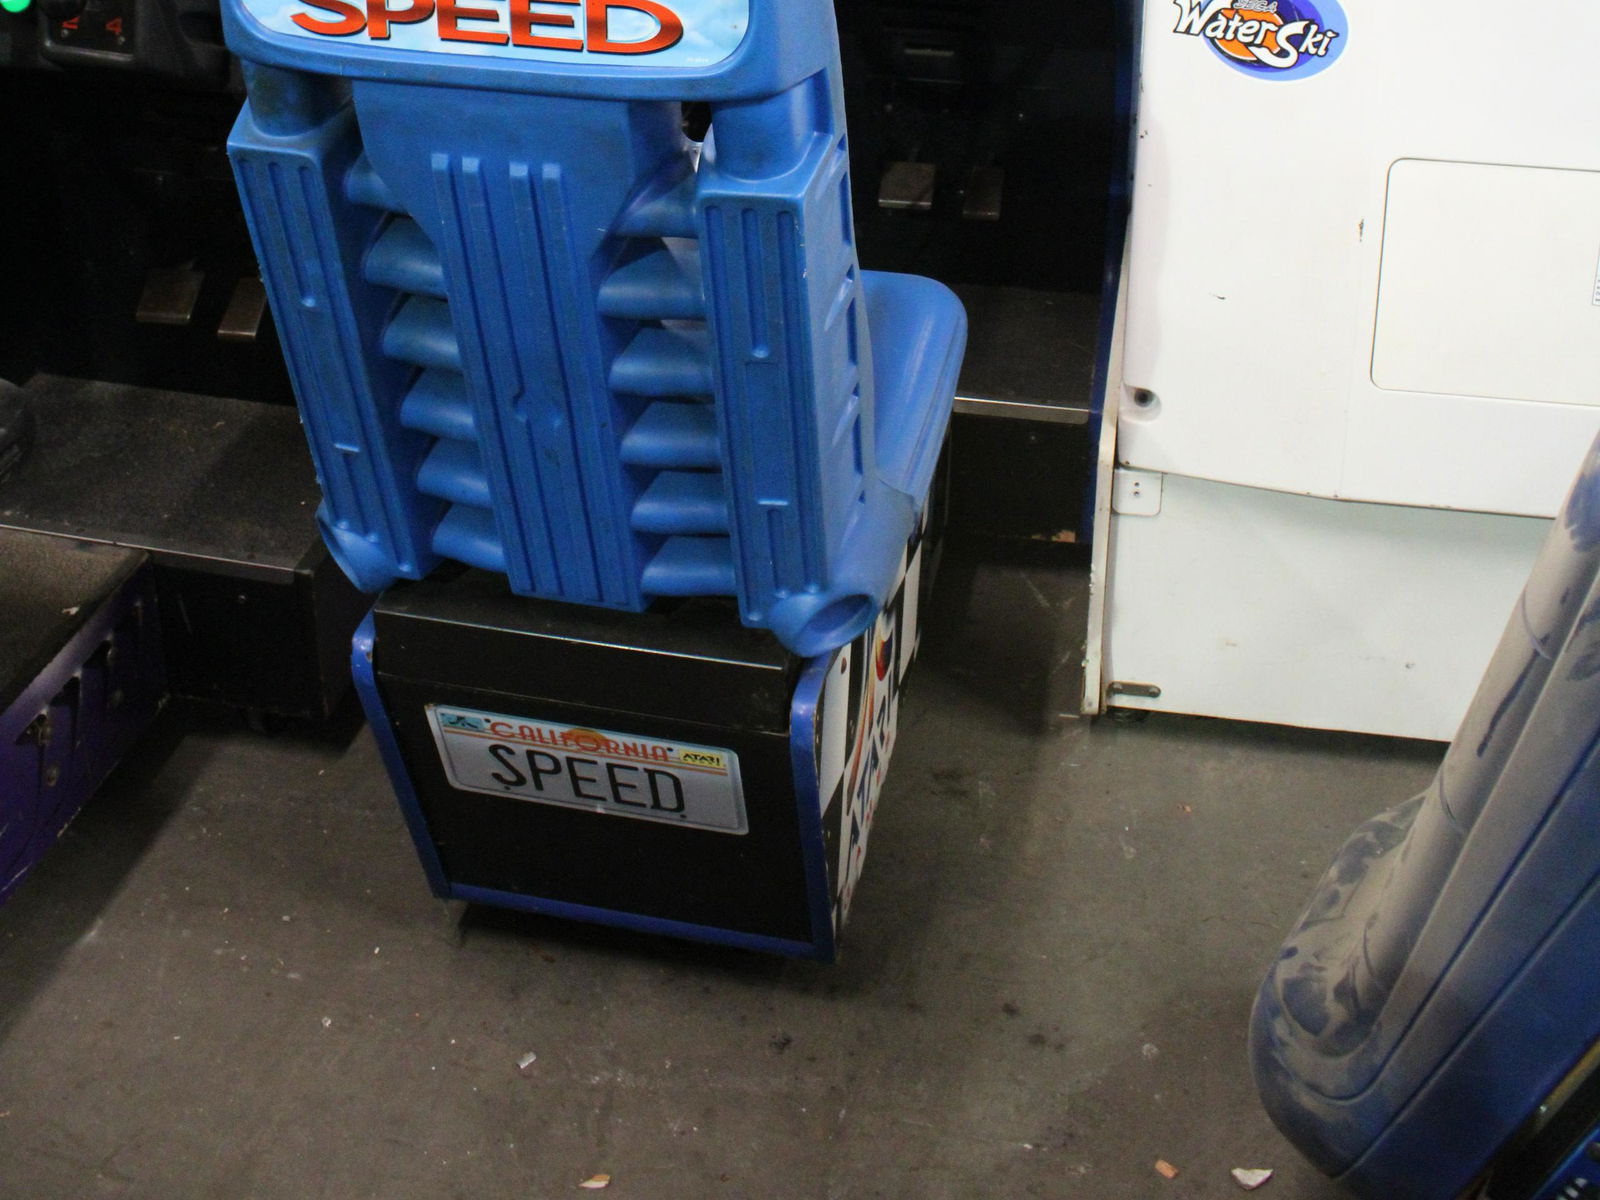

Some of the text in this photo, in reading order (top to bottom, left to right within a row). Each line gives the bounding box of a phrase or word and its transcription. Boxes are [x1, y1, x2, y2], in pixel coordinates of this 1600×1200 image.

[105, 16, 123, 36] 4
[1247, 18, 1340, 69] Ski
[489, 721, 671, 762] CALIFORNIA
[682, 753, 720, 766] ATARI
[488, 744, 686, 814] SPEED
